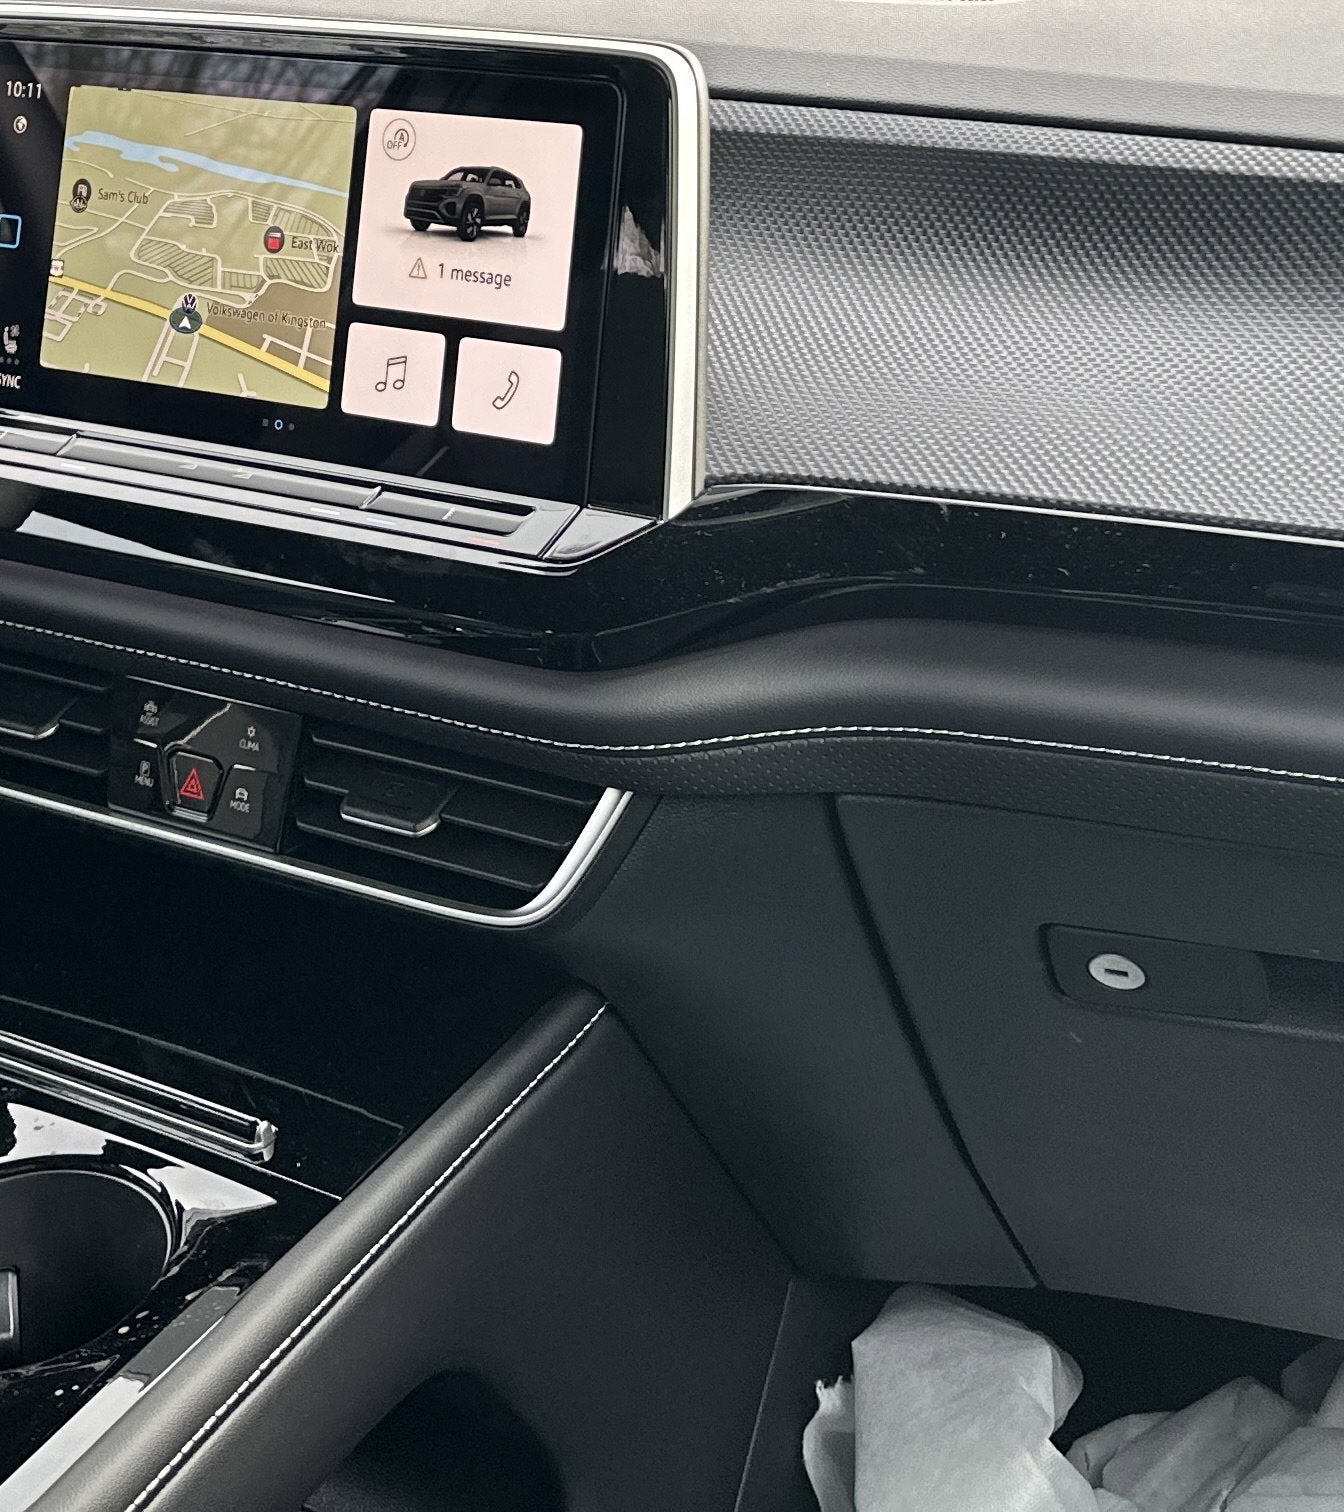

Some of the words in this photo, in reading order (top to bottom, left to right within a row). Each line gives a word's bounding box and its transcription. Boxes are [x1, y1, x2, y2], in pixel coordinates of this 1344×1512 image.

[6, 80, 42, 99] 10:11
[386, 139, 402, 150] OFF
[97, 187, 125, 202] Sam's
[127, 190, 149, 205] Club
[291, 236, 312, 250] East
[316, 240, 340, 253] Wok
[438, 262, 445, 279] 1
[450, 267, 512, 290] message
[207, 301, 265, 323] Volkswagen
[268, 311, 278, 323] of
[282, 312, 327, 330] Kingston
[239, 739, 260, 752] CLIMA
[229, 799, 251, 814] MODE
